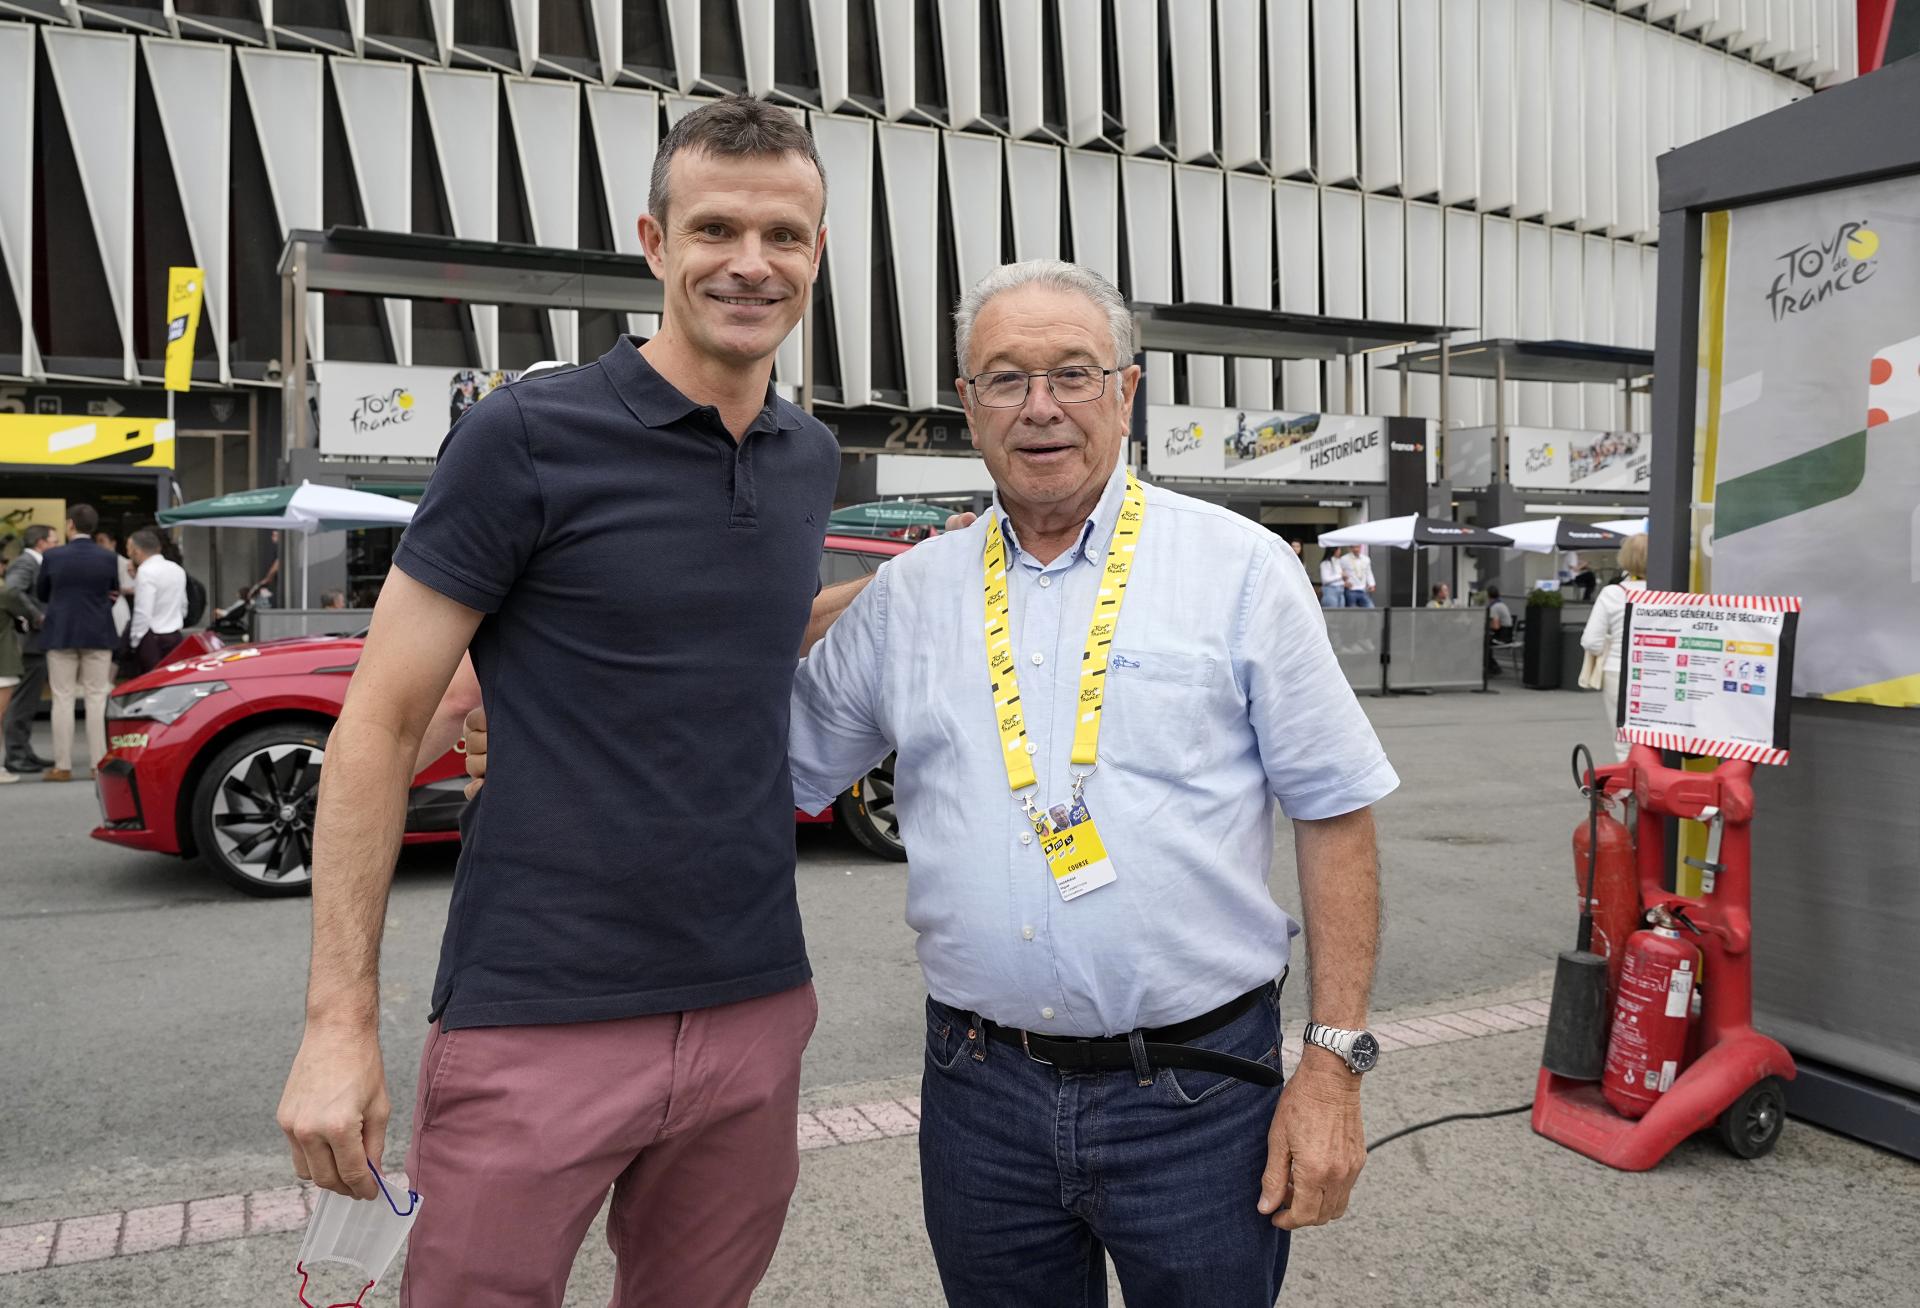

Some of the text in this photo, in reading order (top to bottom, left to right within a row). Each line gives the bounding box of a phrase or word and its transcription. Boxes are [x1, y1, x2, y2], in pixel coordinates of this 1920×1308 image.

[885, 415, 929, 449] 24
[1310, 430, 1378, 470] HISTORIQUE
[1636, 608, 1779, 625] CONSIGNES GÉNÉRALES DE SÉCURITÉ
[1067, 859, 1089, 872] COURSE
